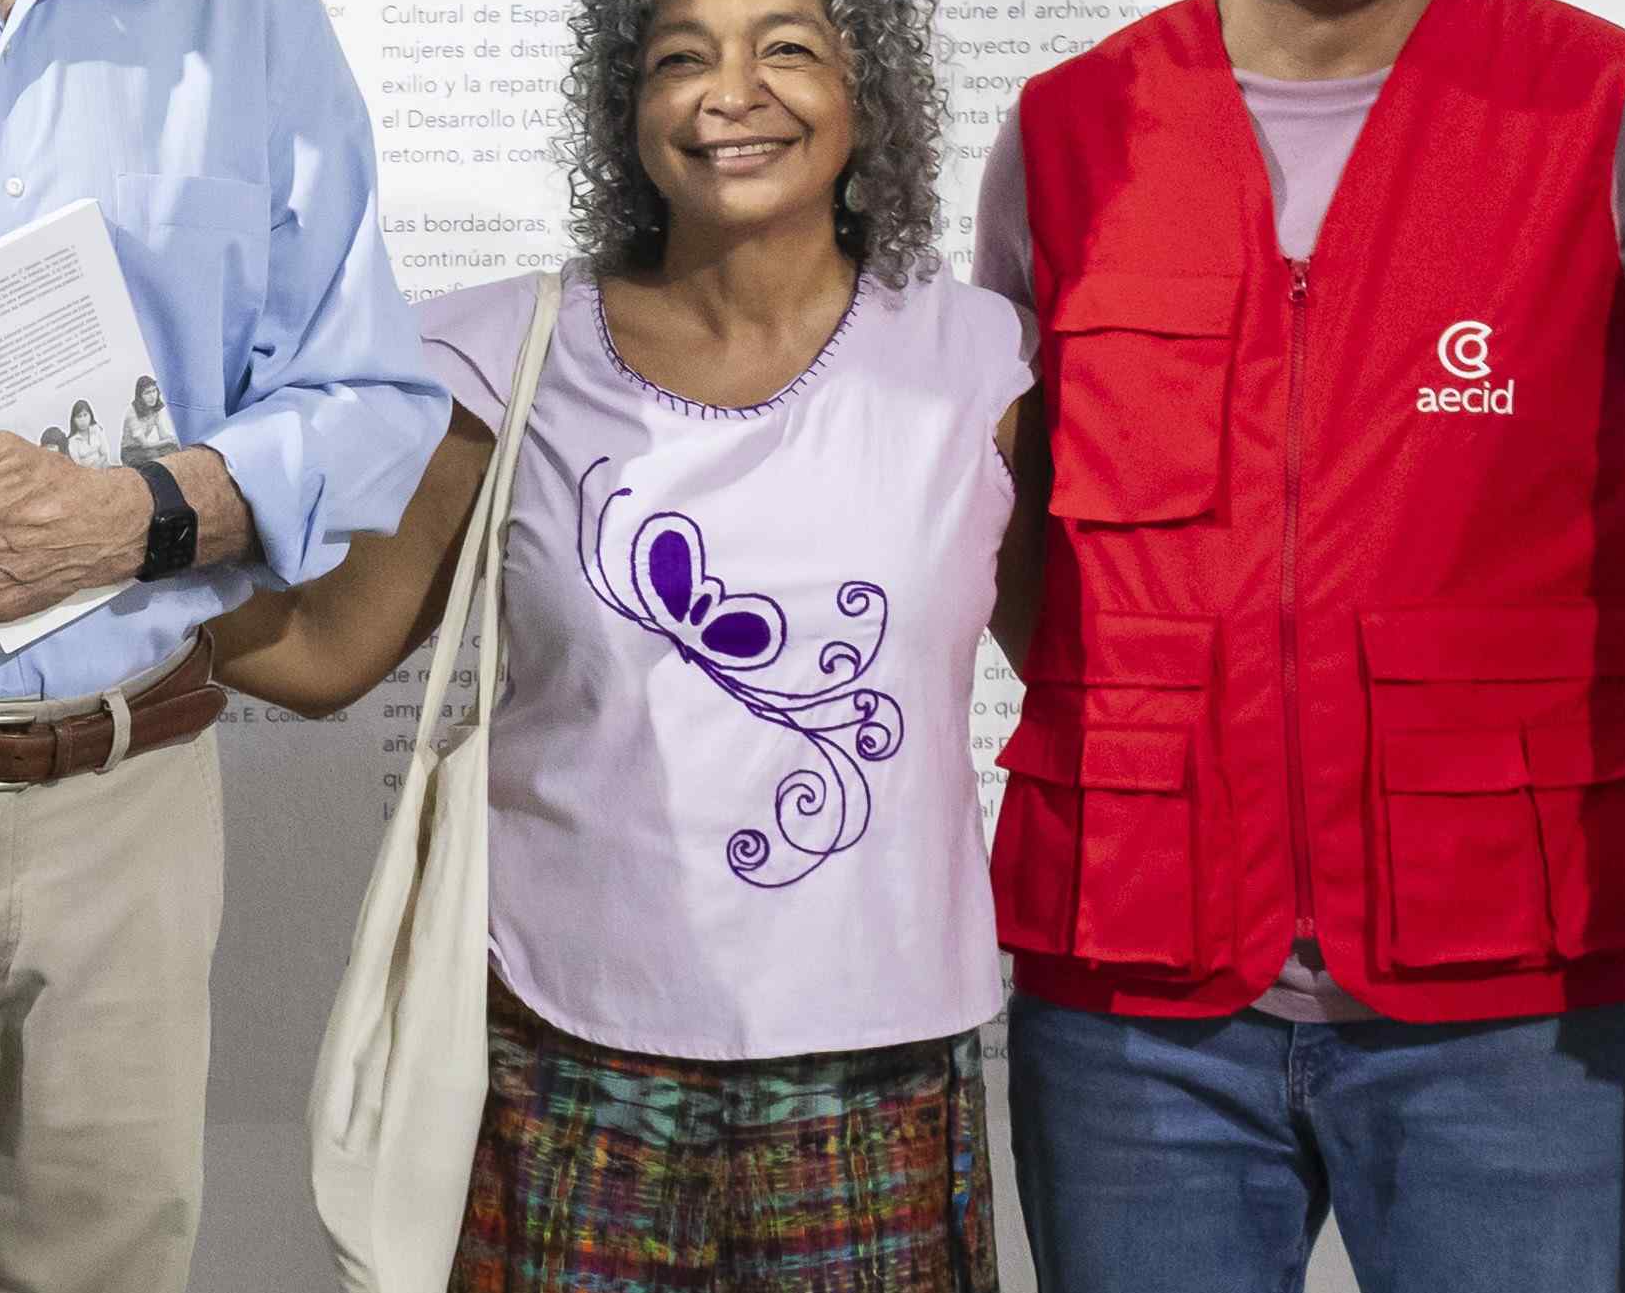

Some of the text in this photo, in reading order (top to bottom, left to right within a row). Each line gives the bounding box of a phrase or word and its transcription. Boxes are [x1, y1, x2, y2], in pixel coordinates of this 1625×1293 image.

[381, 4, 464, 24] Cultural
[473, 4, 501, 24] de
[1007, 0, 1025, 19] el
[382, 41, 464, 64] mujeres
[473, 39, 501, 58] de
[382, 74, 437, 94] exilio
[445, 79, 457, 98] y
[464, 74, 482, 94] la
[962, 76, 1027, 95] apoyo
[382, 109, 399, 129] el
[407, 108, 515, 129] Desarrollo
[382, 147, 465, 166] retorno,
[383, 215, 416, 233] Las
[424, 214, 551, 235] bordadoras,
[402, 248, 506, 268] continúan
[1415, 379, 1515, 416] aecid
